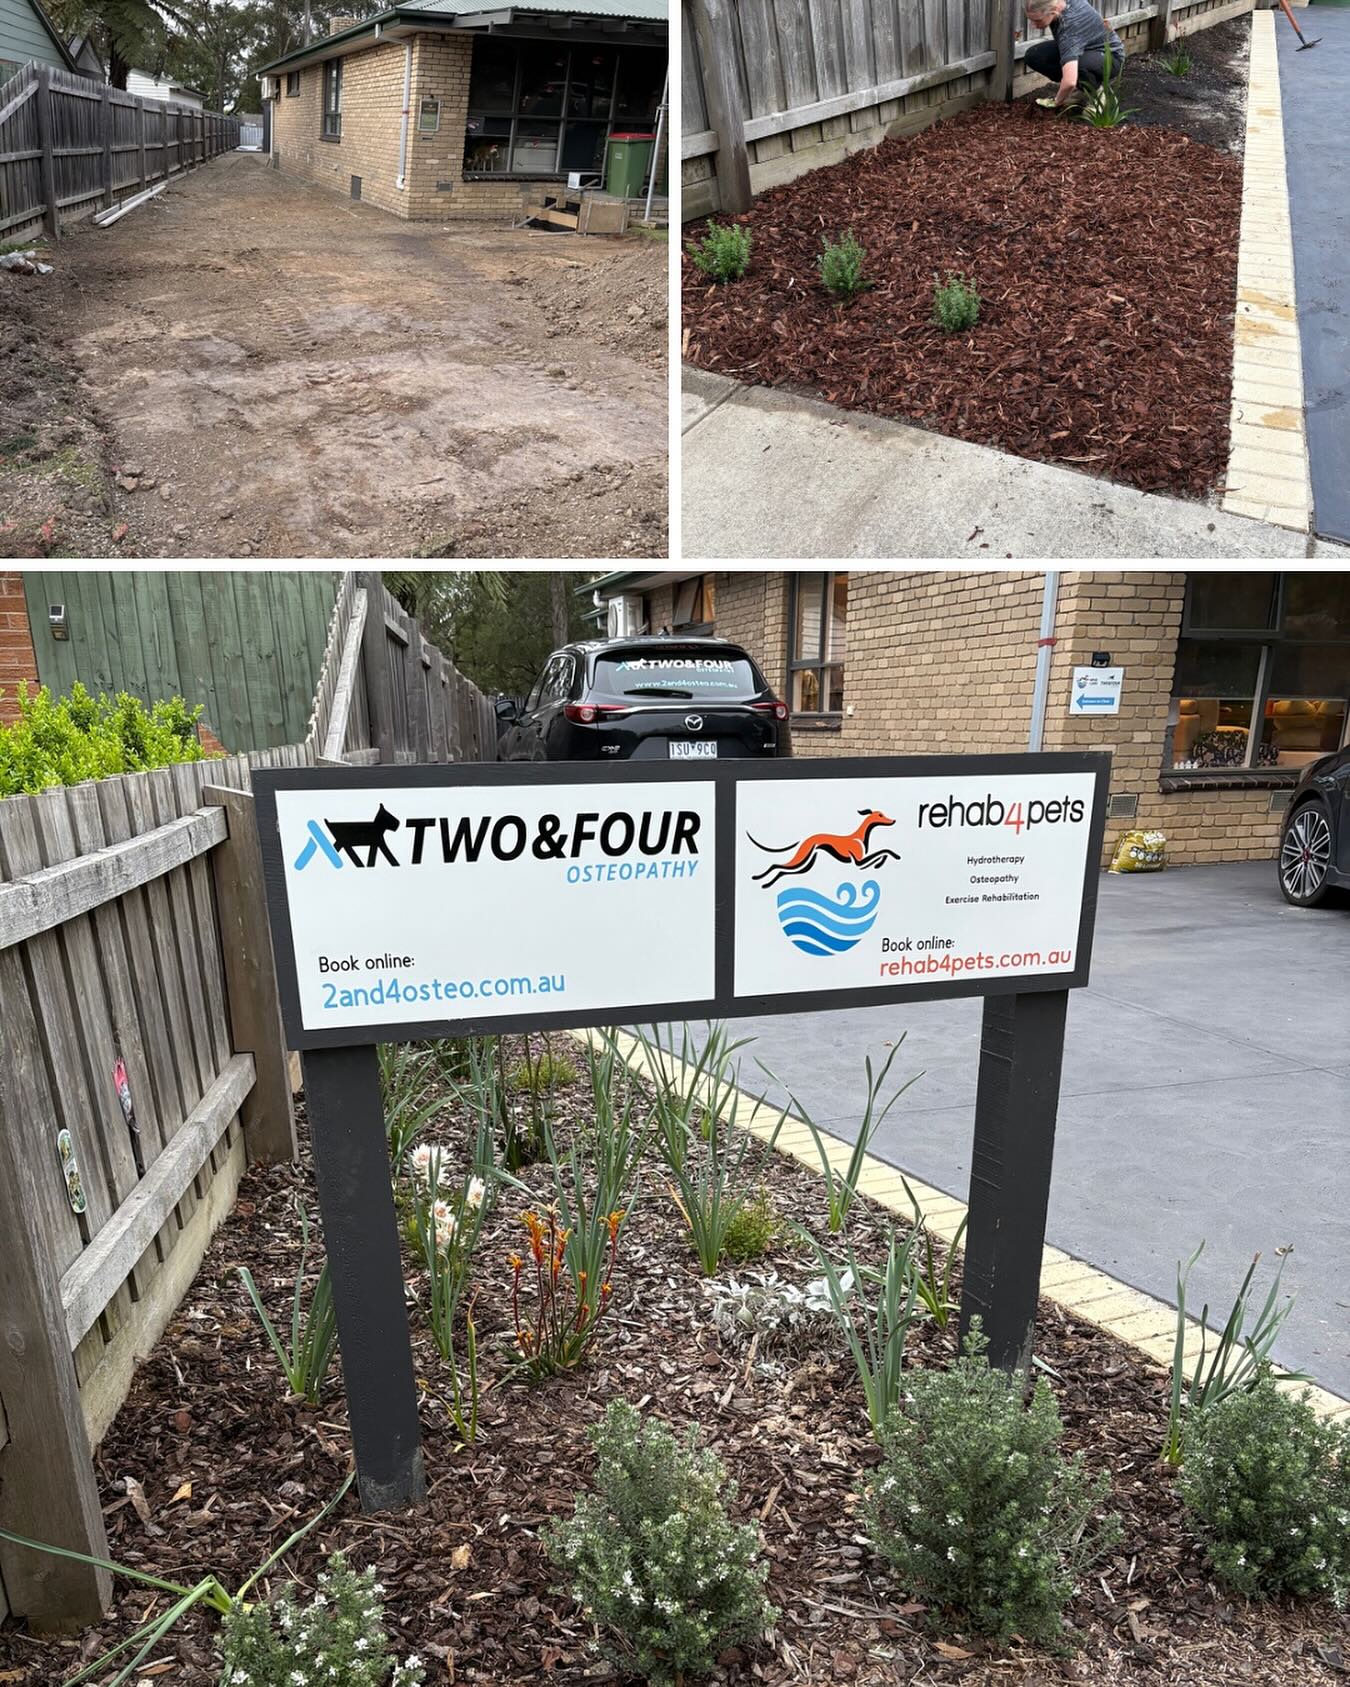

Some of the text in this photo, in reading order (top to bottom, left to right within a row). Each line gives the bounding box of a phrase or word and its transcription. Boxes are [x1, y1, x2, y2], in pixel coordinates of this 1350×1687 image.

[648, 659, 733, 670] TWO&FOUR
[918, 793, 1085, 834] rehab4pets
[405, 810, 702, 866] TWO&FOUR
[566, 860, 699, 884] OSTEOPATHY
[966, 855, 1026, 867] Hydrotherapy
[969, 874, 1020, 886] Osteopathy
[945, 891, 1040, 905] Exercise Rehabilitation
[881, 935, 956, 953] Book online:
[318, 952, 416, 974] Book online:
[879, 948, 1072, 977] rehab4pets.com.au
[321, 973, 566, 1009] 2and4osteo.com.au
